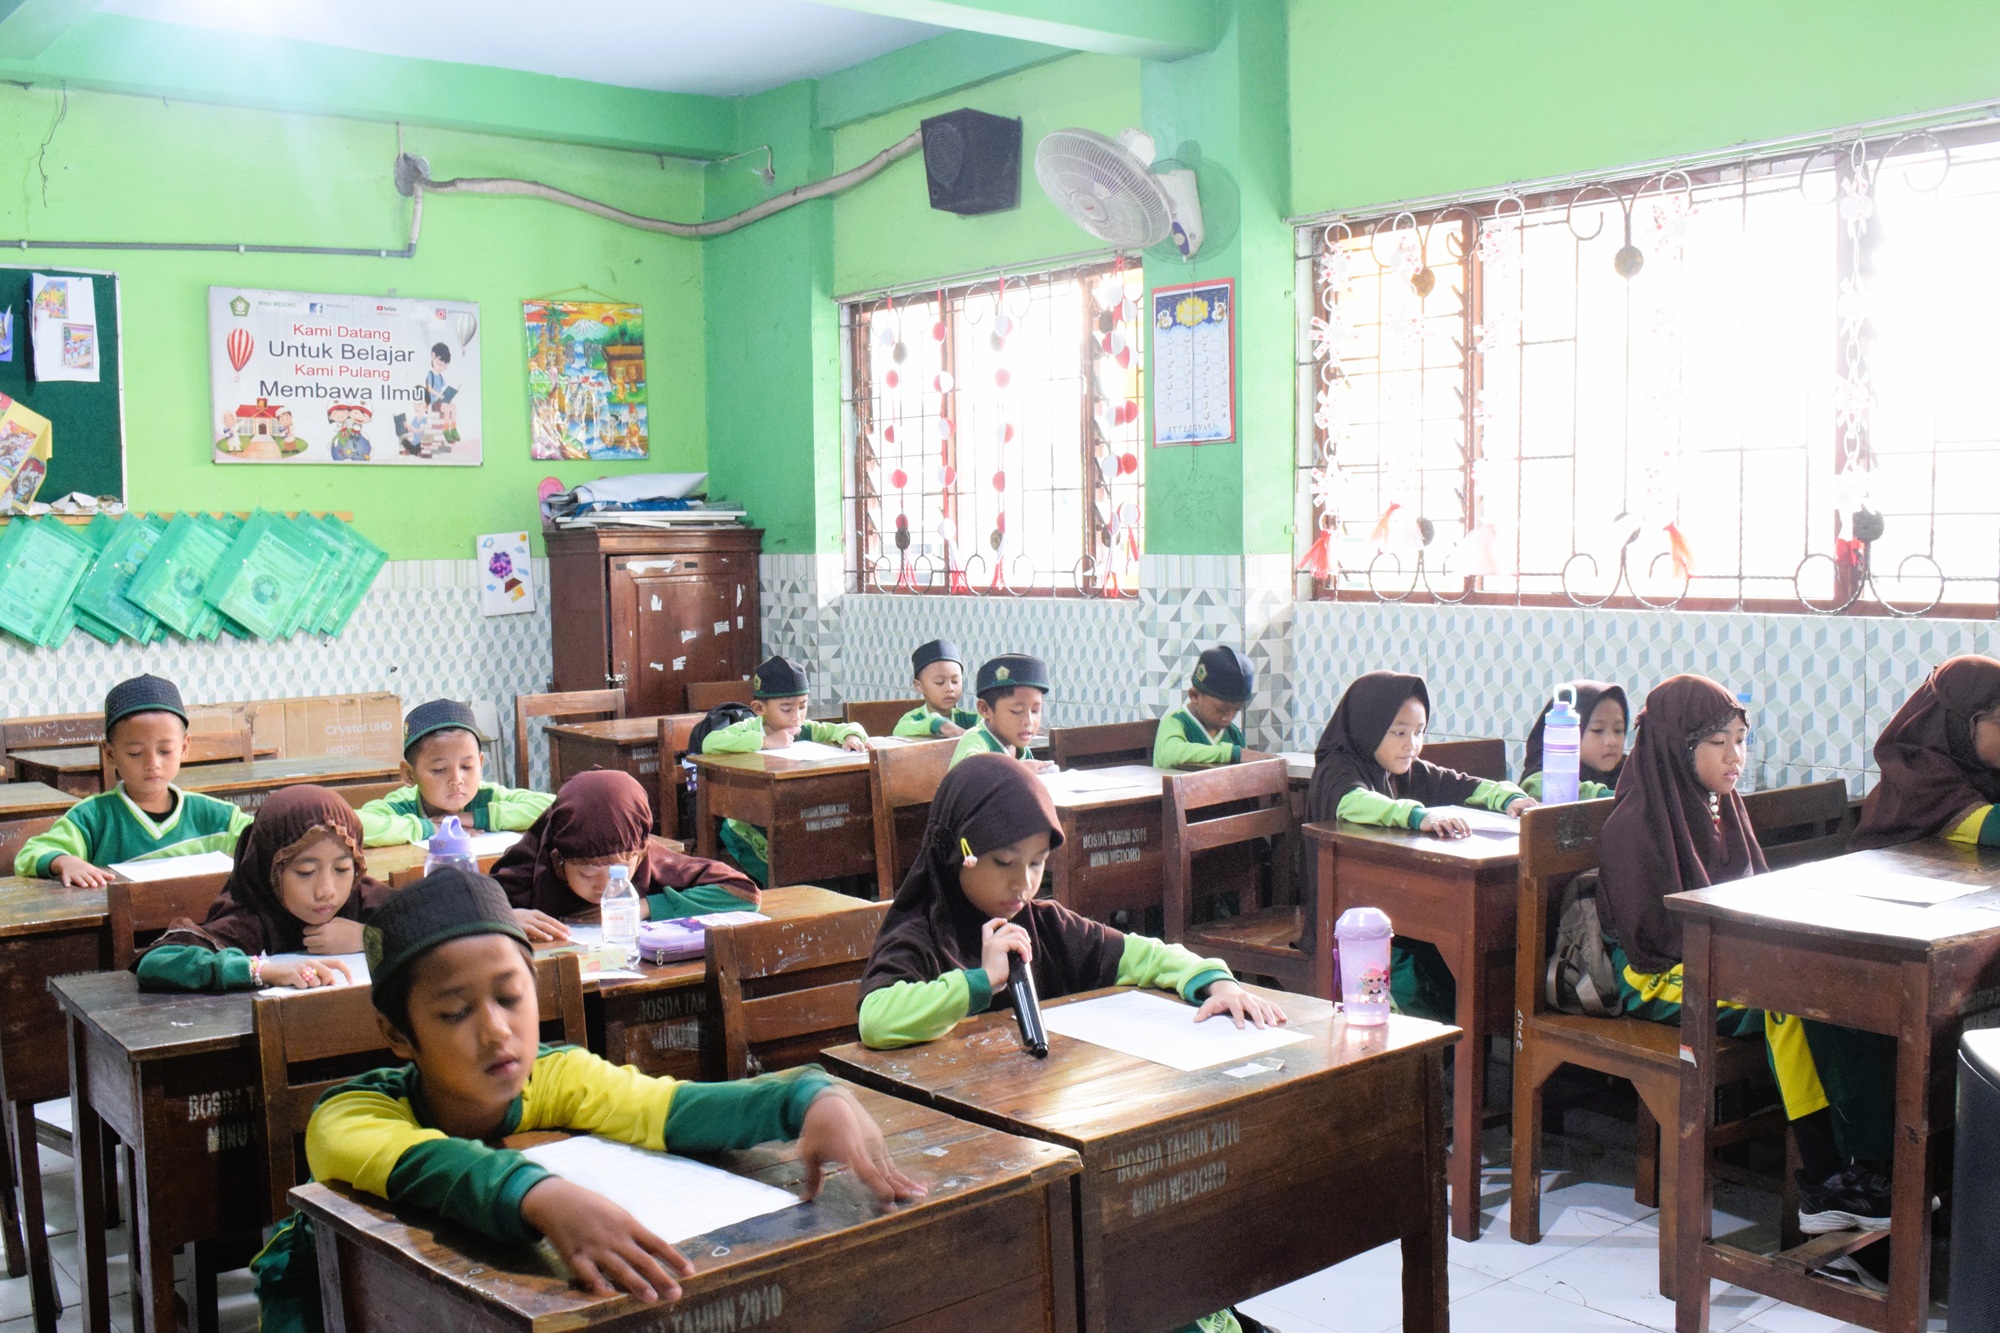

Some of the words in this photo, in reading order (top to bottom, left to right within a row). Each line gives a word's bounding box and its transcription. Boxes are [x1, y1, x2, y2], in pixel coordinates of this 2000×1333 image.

[293, 323, 332, 337] Kami
[337, 325, 391, 342] Datang
[268, 340, 333, 359] Untuk
[341, 343, 415, 365] Belajar
[295, 363, 333, 377] Kami
[339, 365, 390, 382] Pulang
[260, 380, 373, 400] Membawa
[381, 384, 423, 401] Ilmu
[325, 722, 367, 735] Crystal
[370, 721, 392, 732] UHD
[1083, 832, 1108, 849] BOSDA
[1108, 828, 1131, 846] TAHUN
[1090, 852, 1109, 867] MINU
[1109, 847, 1141, 863] WEDORO
[1117, 1139, 1164, 1183] BOSDA
[1167, 1126, 1208, 1167] TAHUN
[1211, 1118, 1240, 1151] 2010
[1132, 1180, 1166, 1218] MINU
[671, 1299, 736, 1333] TAHUN
[740, 1283, 783, 1329] 2010
